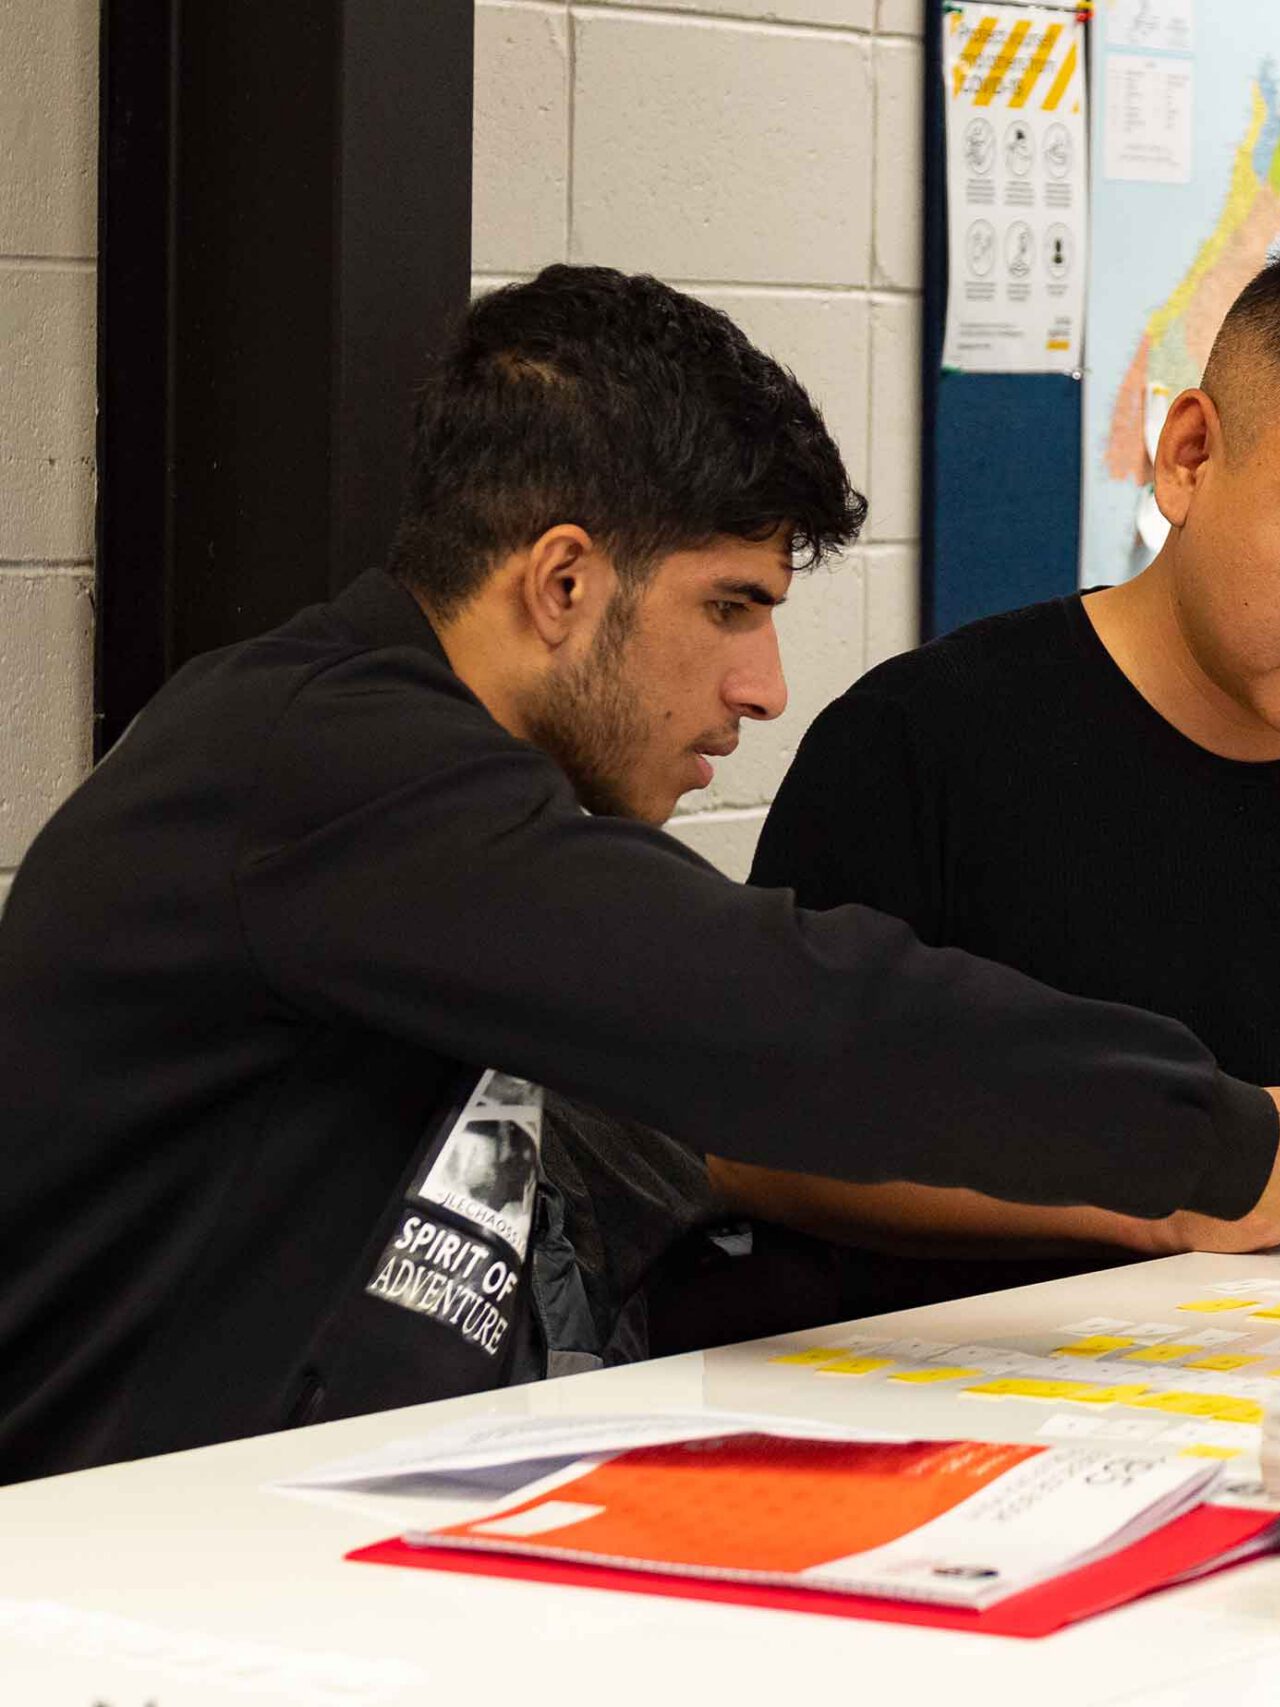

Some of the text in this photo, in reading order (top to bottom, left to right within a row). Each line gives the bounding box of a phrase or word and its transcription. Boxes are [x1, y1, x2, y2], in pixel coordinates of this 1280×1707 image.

[395, 1216, 518, 1302] SPIRIT OF
[371, 1256, 509, 1356] ADVENTURE
